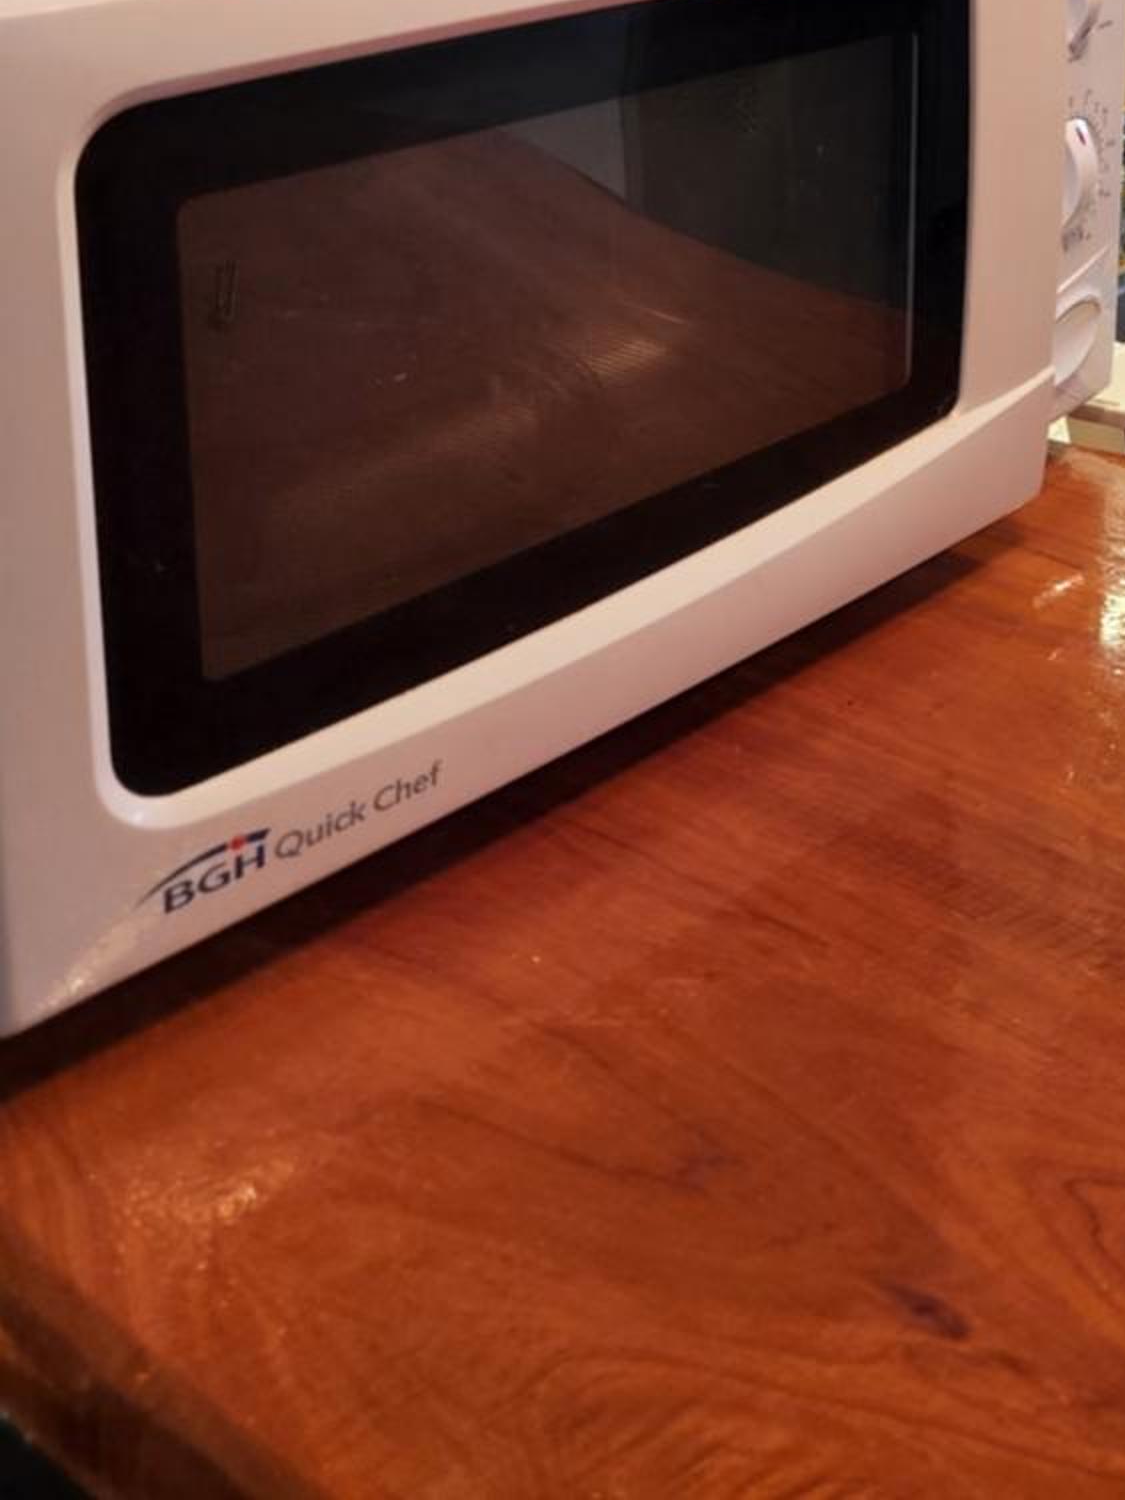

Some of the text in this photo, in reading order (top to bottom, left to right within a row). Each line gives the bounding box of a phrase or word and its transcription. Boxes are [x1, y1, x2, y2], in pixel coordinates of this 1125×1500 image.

[162, 759, 444, 914] BGH Quick Chef
